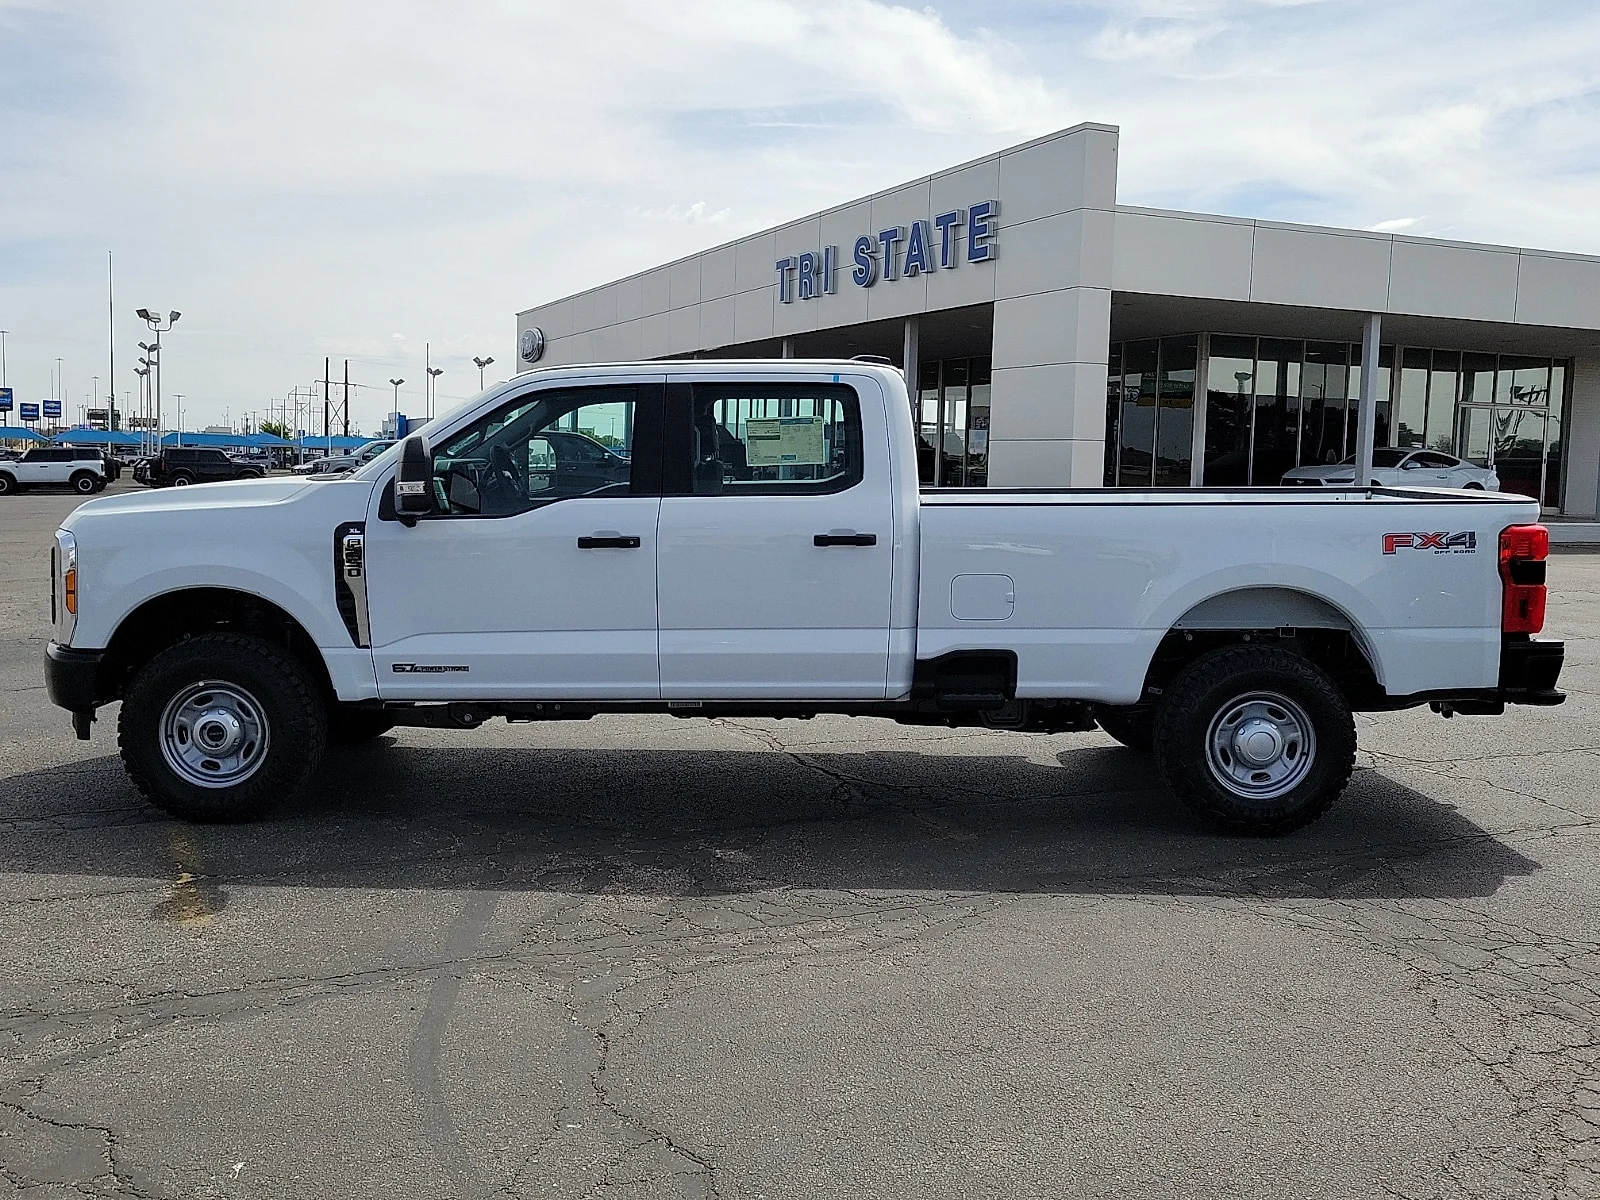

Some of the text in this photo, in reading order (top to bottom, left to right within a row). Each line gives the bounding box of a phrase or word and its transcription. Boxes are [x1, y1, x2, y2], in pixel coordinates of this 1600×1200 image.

[776, 200, 997, 303] TRI STATE
[1382, 531, 1476, 555] FX4
